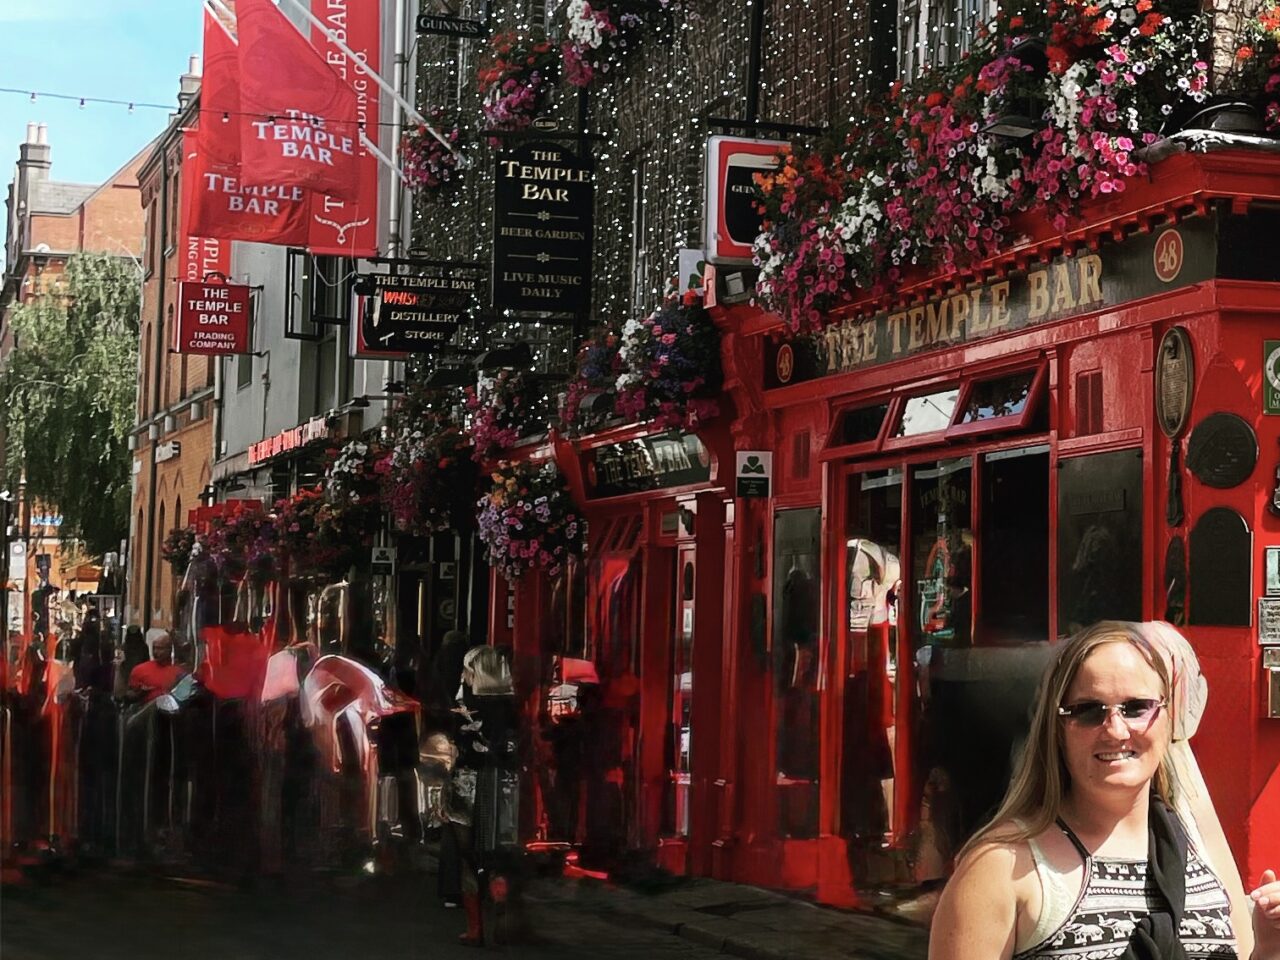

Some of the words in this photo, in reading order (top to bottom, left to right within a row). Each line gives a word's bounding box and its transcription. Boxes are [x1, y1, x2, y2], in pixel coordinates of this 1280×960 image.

[420, 16, 479, 34] GUINNESS
[285, 108, 326, 130] THE
[251, 121, 354, 155] TEMPLE
[281, 141, 334, 166] BAR
[530, 150, 562, 162] THE
[500, 160, 591, 183] TEMPLE
[521, 183, 569, 202] BAR
[731, 184, 756, 194] GUIN
[228, 196, 279, 216] BAR
[500, 226, 533, 238] BEER
[535, 228, 585, 241] GARDEN
[1158, 240, 1178, 272] 48
[374, 275, 399, 286] THE
[401, 277, 448, 289] TEMPLE
[451, 279, 476, 290] BAR
[503, 271, 535, 283] LIVE
[537, 273, 583, 285] MUSIC
[202, 287, 229, 300] THE
[521, 286, 563, 299] DAILY
[187, 300, 242, 313] TEMPLE
[825, 318, 878, 371] THE
[887, 280, 1010, 353] TEMPLE
[1027, 253, 1104, 319] BAR
[199, 313, 229, 326] BAR
[390, 310, 460, 323] DISTILLERY
[194, 331, 235, 341] TRADING
[404, 330, 445, 340] STORE
[189, 340, 237, 350] COMPANY
